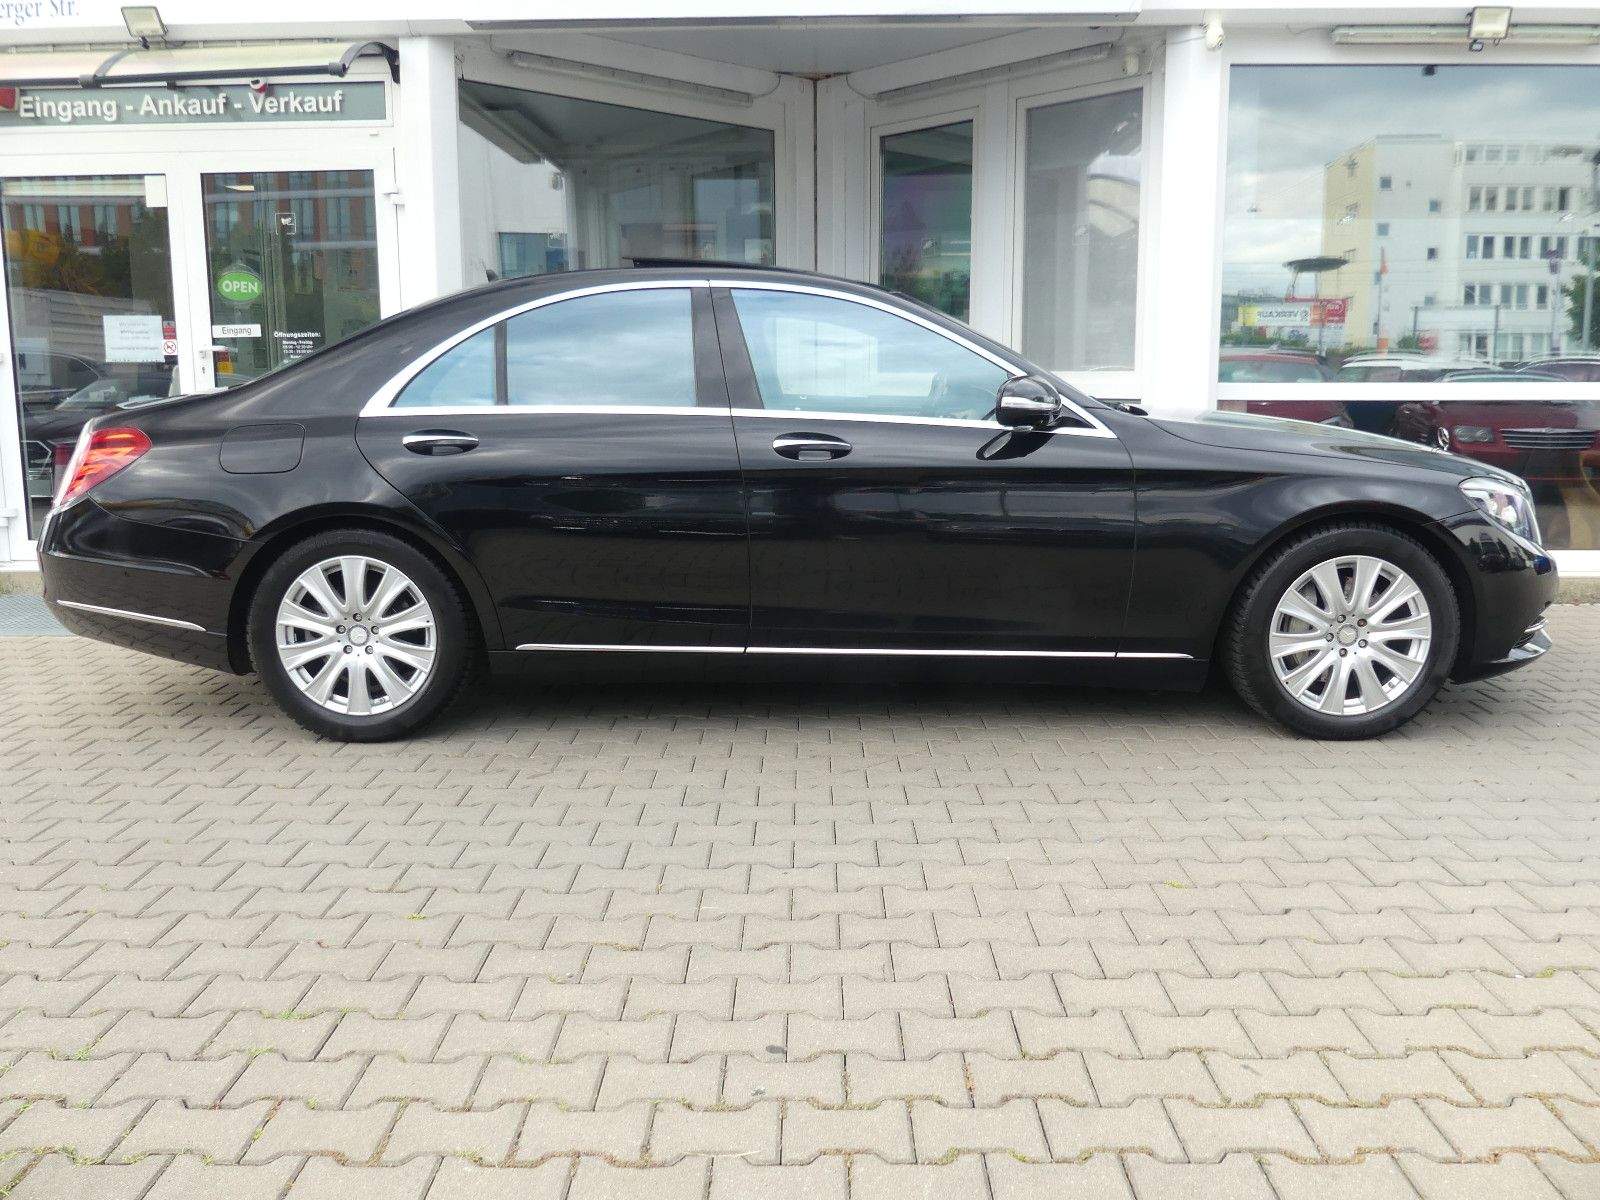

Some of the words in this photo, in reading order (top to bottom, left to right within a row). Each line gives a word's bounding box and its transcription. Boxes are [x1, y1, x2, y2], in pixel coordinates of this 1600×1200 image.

[20, 95, 118, 122] Eingang
[140, 93, 227, 116] Ankauf
[249, 90, 343, 114] Verkauf
[222, 280, 259, 293] OPEN
[221, 326, 252, 336] Eingang
